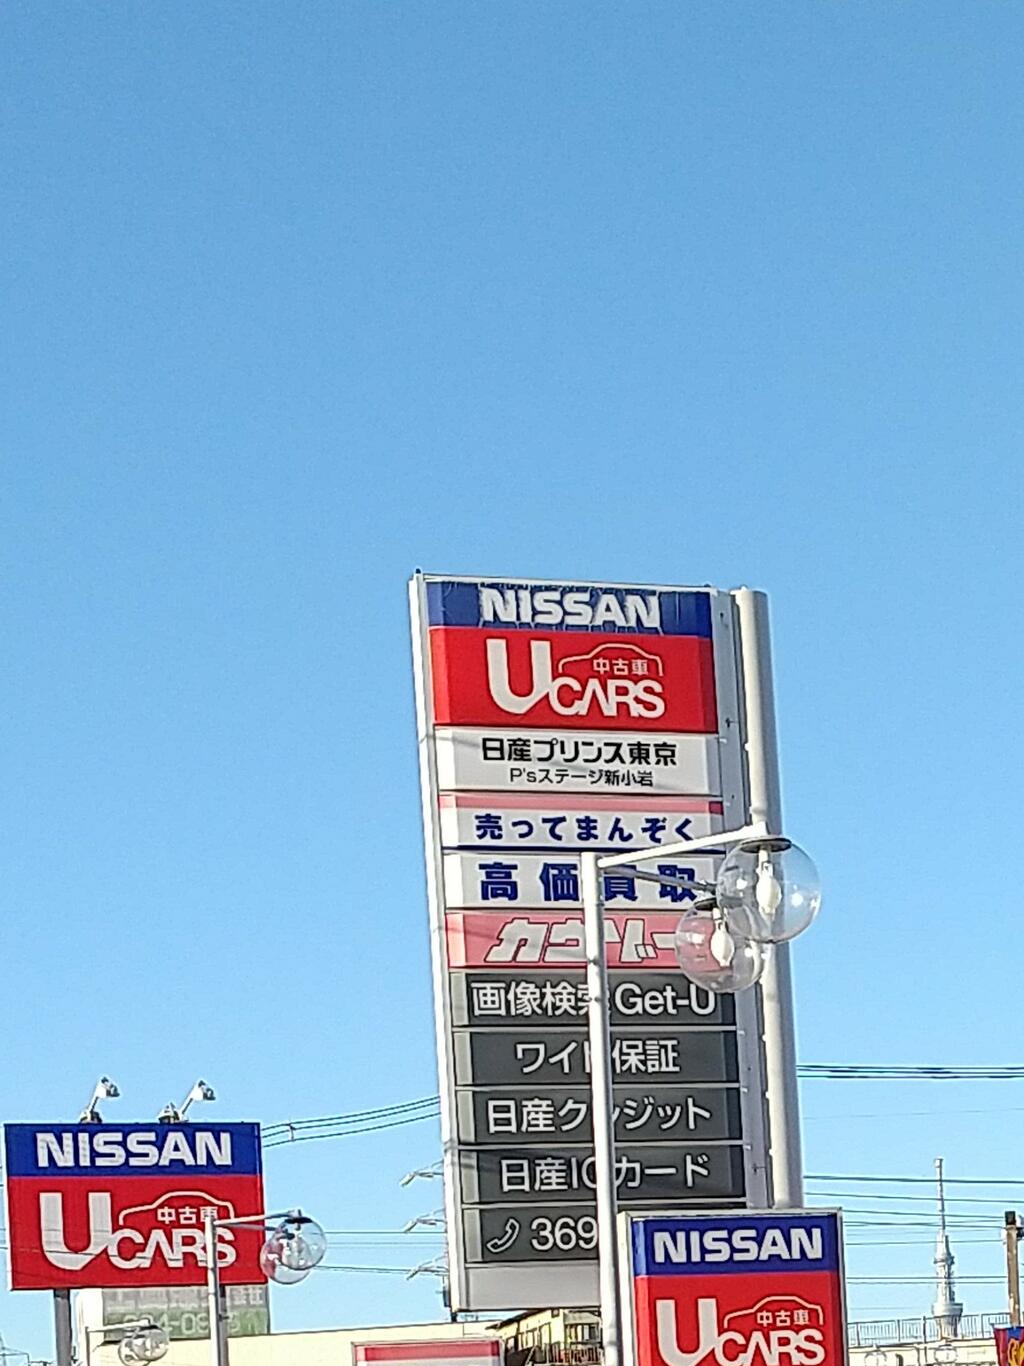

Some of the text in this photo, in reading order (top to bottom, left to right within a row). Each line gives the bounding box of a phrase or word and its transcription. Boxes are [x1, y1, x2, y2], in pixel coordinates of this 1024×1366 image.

[482, 587, 660, 627] NISSAN
[593, 658, 648, 676] 中古車
[482, 737, 678, 767] 日産プリンス東京
[509, 769, 654, 788] P'sステージ新小岩
[475, 814, 694, 844] 売ってまんぞく
[614, 982, 716, 1016] Get-U
[515, 1039, 681, 1075] ワイ保証
[35, 1131, 233, 1168] NISSAN
[653, 1227, 824, 1264] NISSAN
[756, 1309, 810, 1328] 中古車
